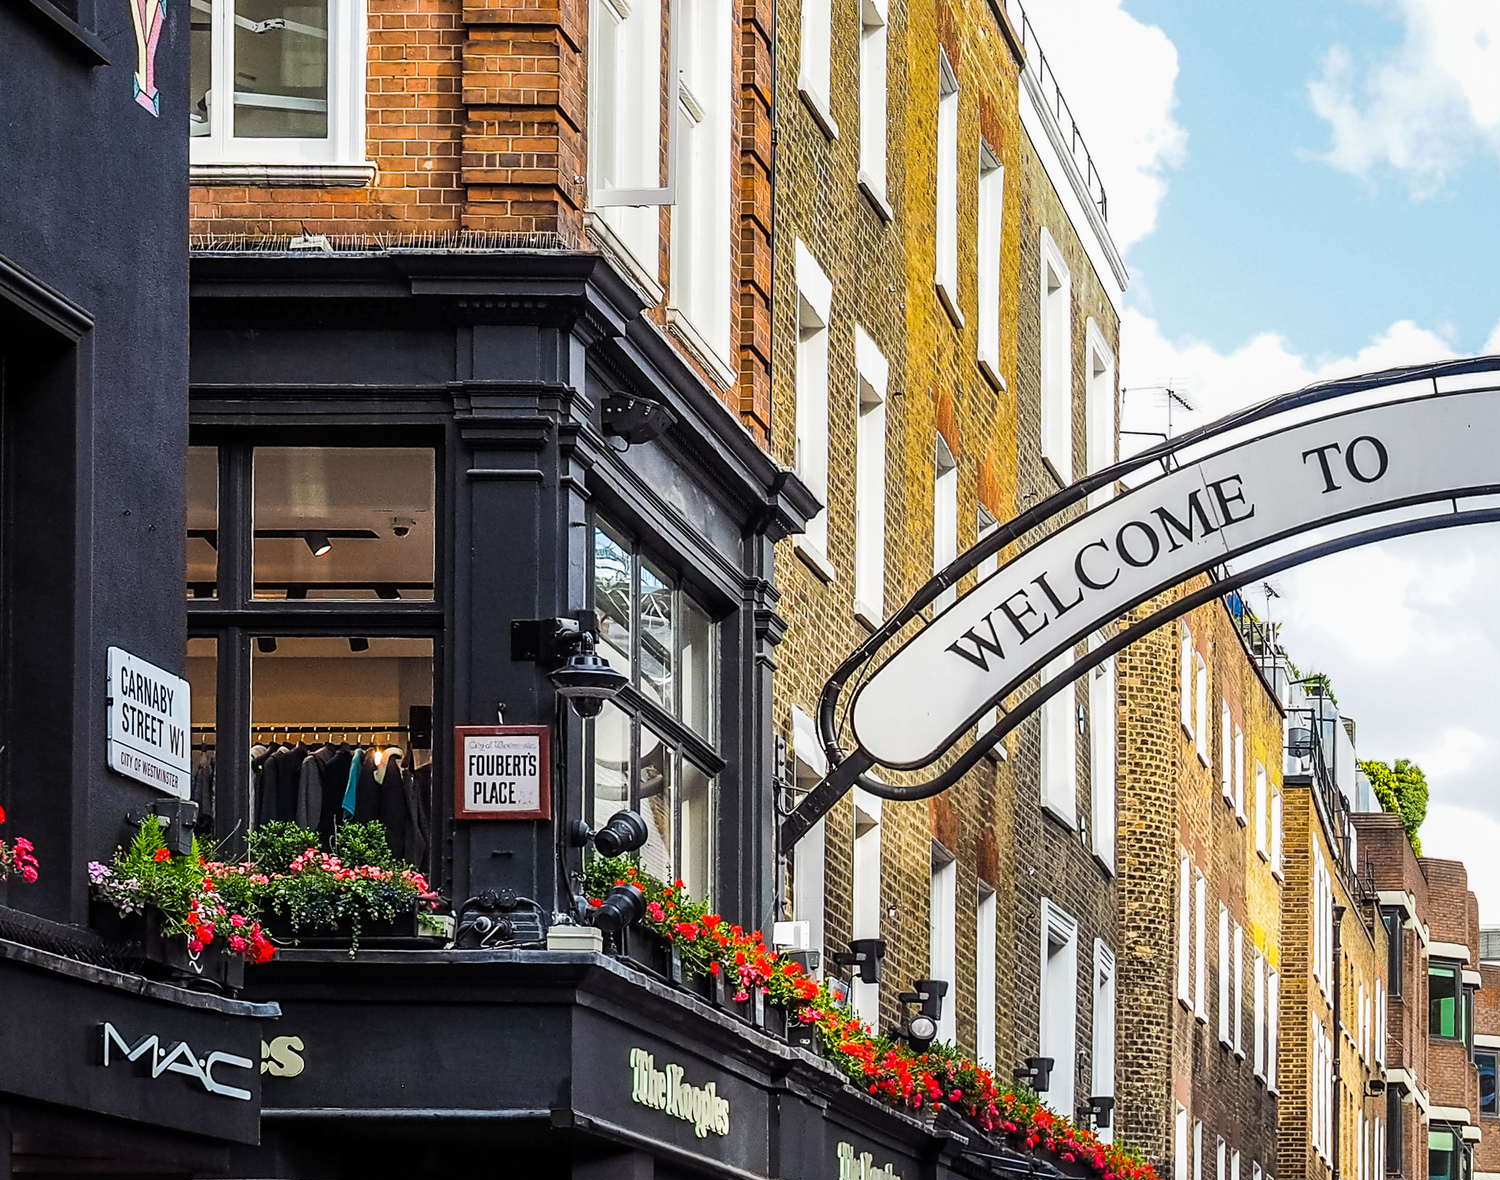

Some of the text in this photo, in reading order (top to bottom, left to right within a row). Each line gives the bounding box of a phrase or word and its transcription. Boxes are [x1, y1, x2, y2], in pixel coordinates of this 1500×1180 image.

[944, 435, 1389, 674] WELCOME TO
[121, 665, 174, 717] CARNABY
[122, 702, 185, 759] STREET W1
[120, 751, 178, 789] CITY OF WESTMINSTER
[468, 752, 537, 776] FOUBERT'S
[473, 781, 516, 804] PLACE
[630, 1047, 729, 1138] The Kooples
